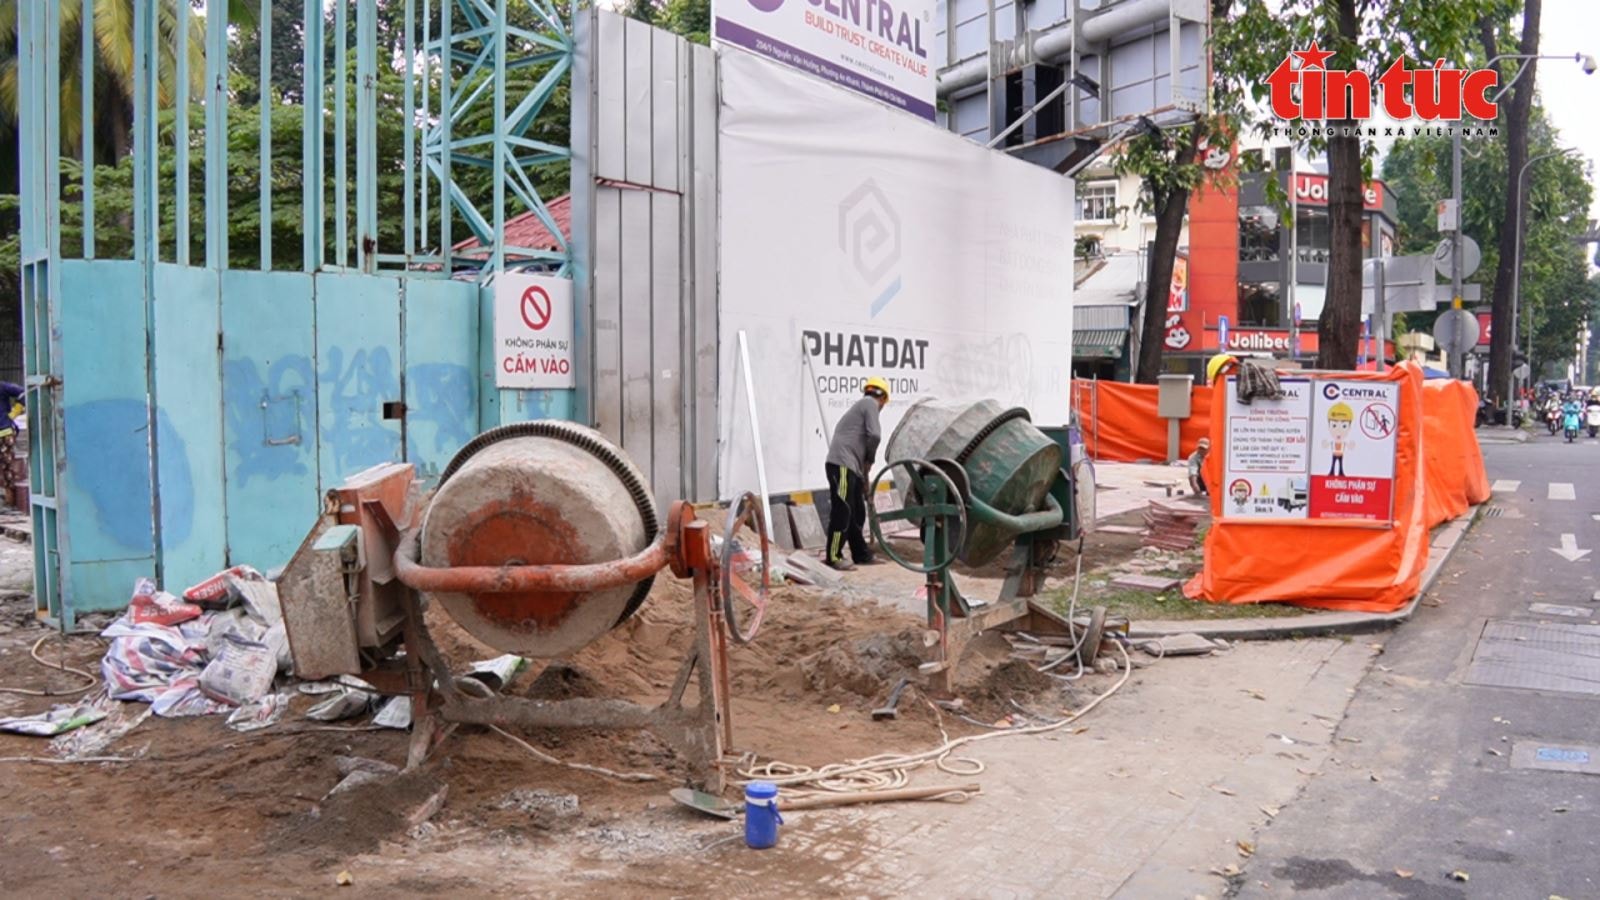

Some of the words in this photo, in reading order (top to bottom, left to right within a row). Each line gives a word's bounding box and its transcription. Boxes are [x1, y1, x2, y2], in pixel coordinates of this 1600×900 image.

[807, 0, 927, 59] NTRAL
[804, 10, 834, 34] BUILD
[868, 40, 900, 66] CREATE
[901, 56, 928, 77] VALUE
[505, 336, 534, 348] KHÔNG
[802, 330, 929, 369] PHATDAT
[503, 351, 537, 374] CẤM
[540, 354, 570, 374] VÀO
[818, 376, 918, 394] CORPOTION
[1342, 388, 1387, 398] CENTRAL
